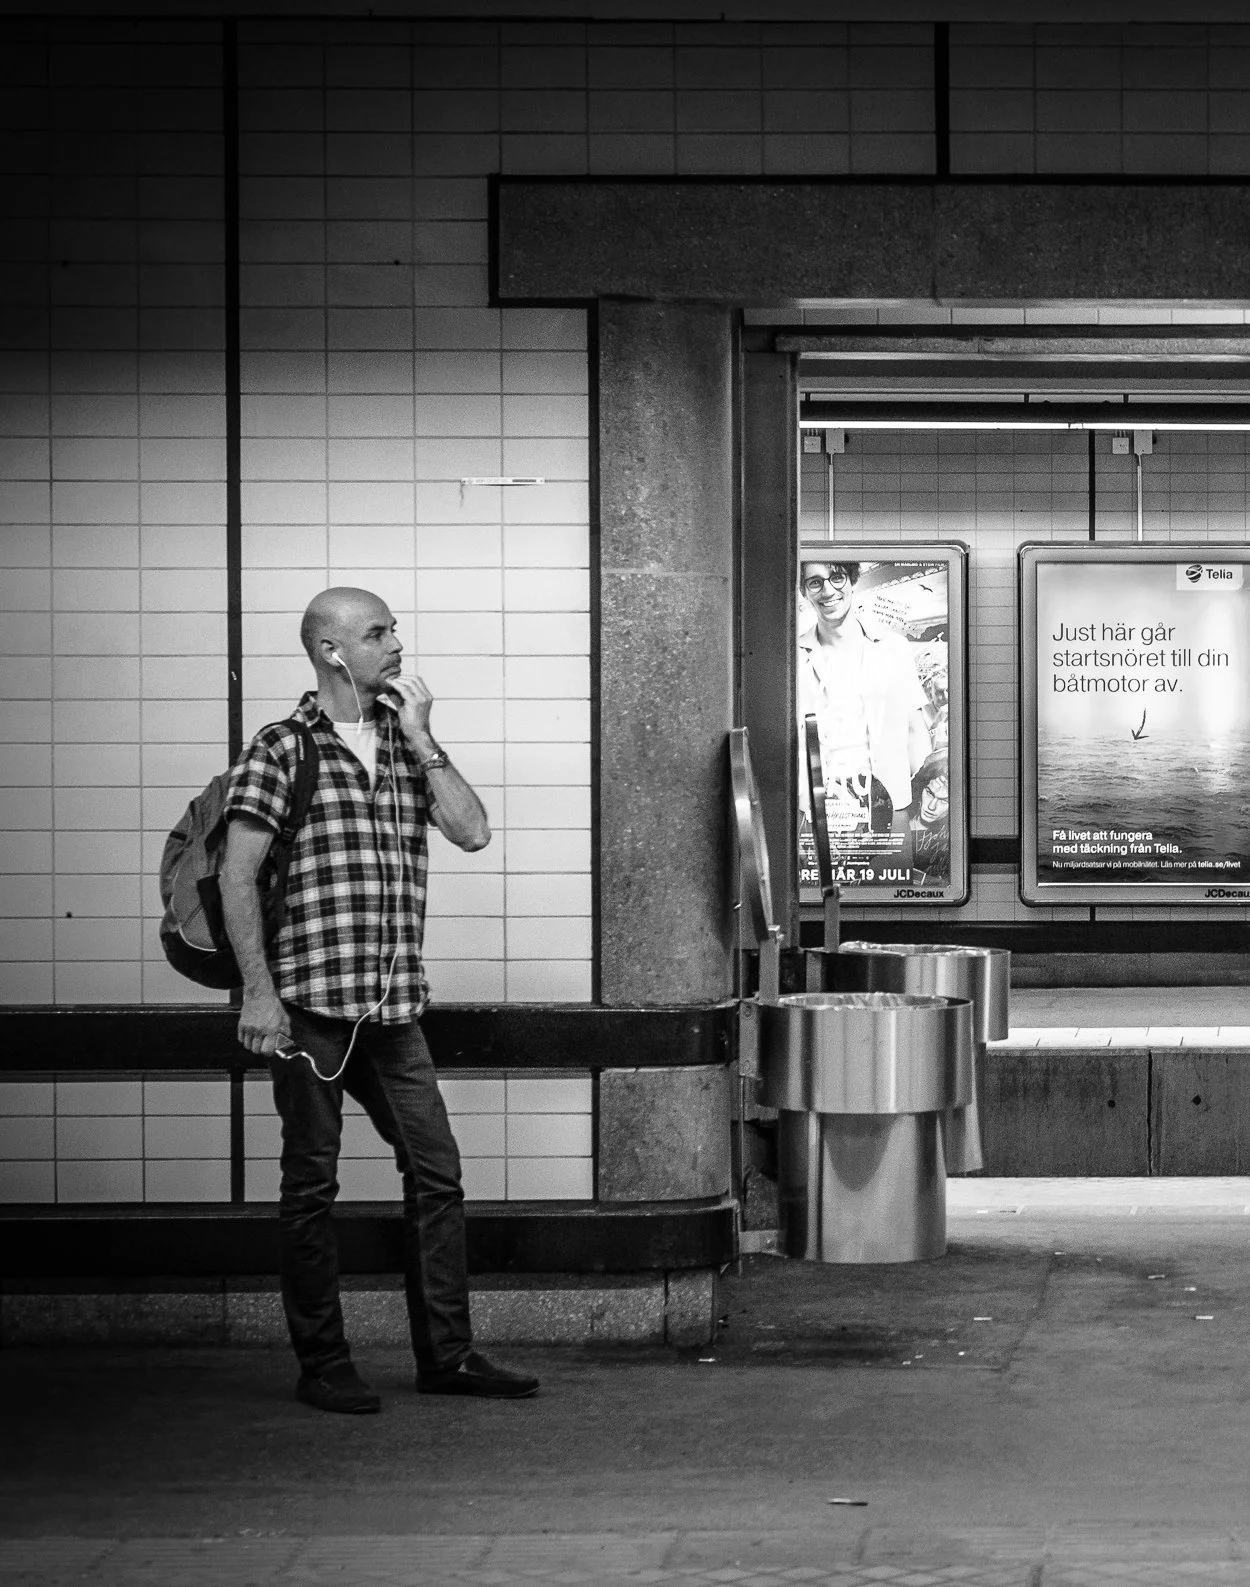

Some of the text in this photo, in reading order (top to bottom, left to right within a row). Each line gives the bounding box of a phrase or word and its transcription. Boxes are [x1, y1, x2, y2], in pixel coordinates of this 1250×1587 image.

[1206, 568, 1233, 580] Telia
[1052, 622, 1176, 646] Just här går
[1052, 648, 1229, 667] startsnöret till din
[1053, 673, 1183, 693] båtmotor av.
[1052, 830, 1153, 843] Få livet att fungera
[1052, 843, 1183, 855] med täckning från Telia.
[1113, 860, 1121, 869] på
[1188, 860, 1197, 869] på
[798, 866, 910, 881] REIÄR 19 JULI
[893, 889, 944, 898] JCDecaux
